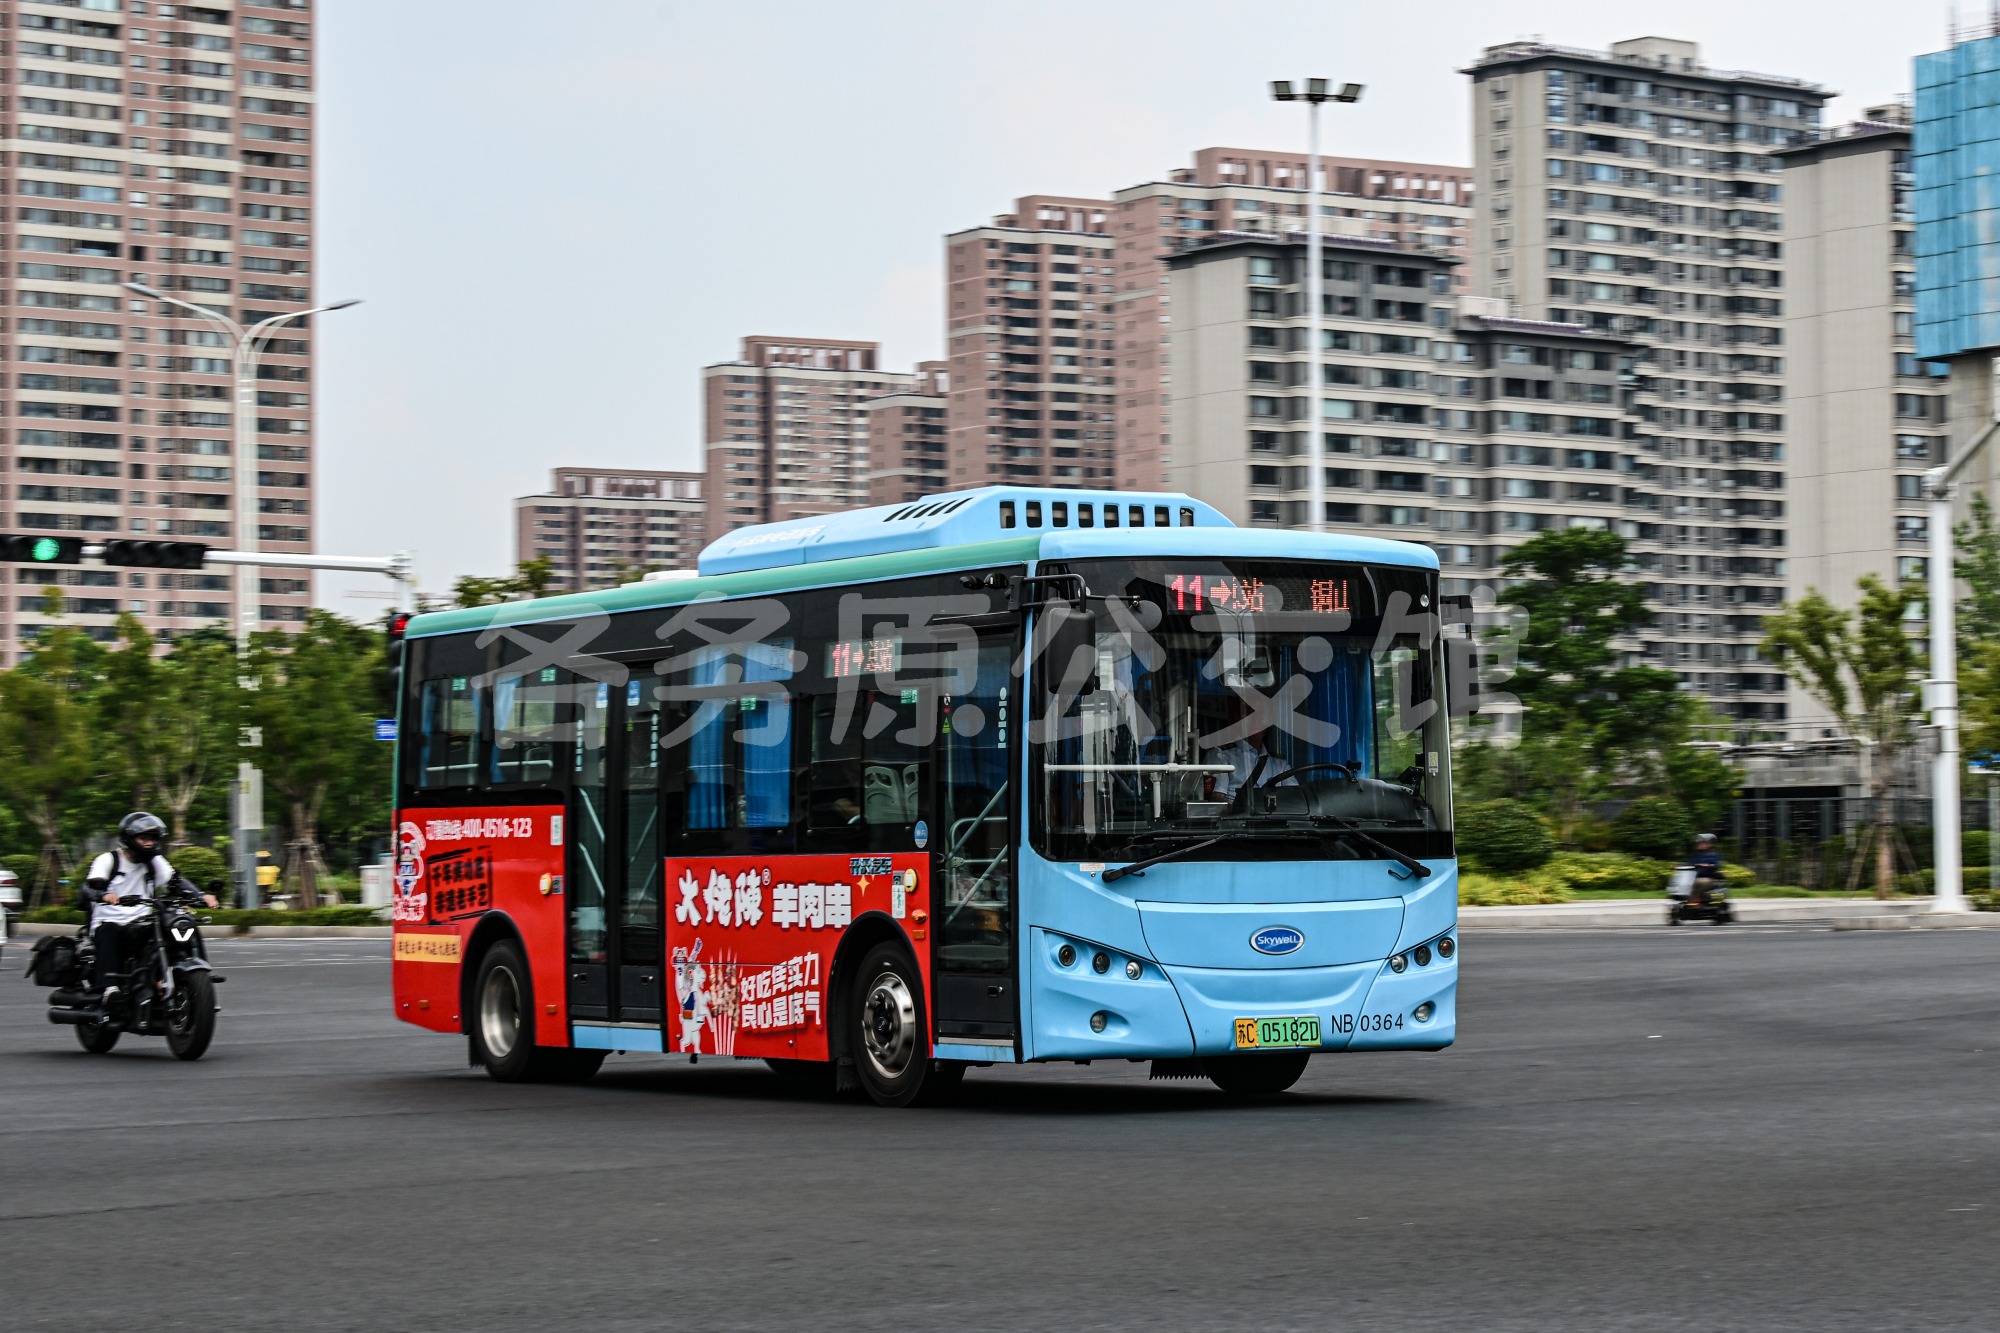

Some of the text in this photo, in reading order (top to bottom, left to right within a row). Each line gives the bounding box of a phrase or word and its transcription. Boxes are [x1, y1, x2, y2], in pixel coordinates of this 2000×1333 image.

[1171, 575, 1203, 611] 11
[832, 643, 850, 676] 11
[772, 883, 852, 928] 羊肉串
[740, 951, 819, 1002] 好吃凭实力
[741, 989, 821, 1029] 良心是底气
